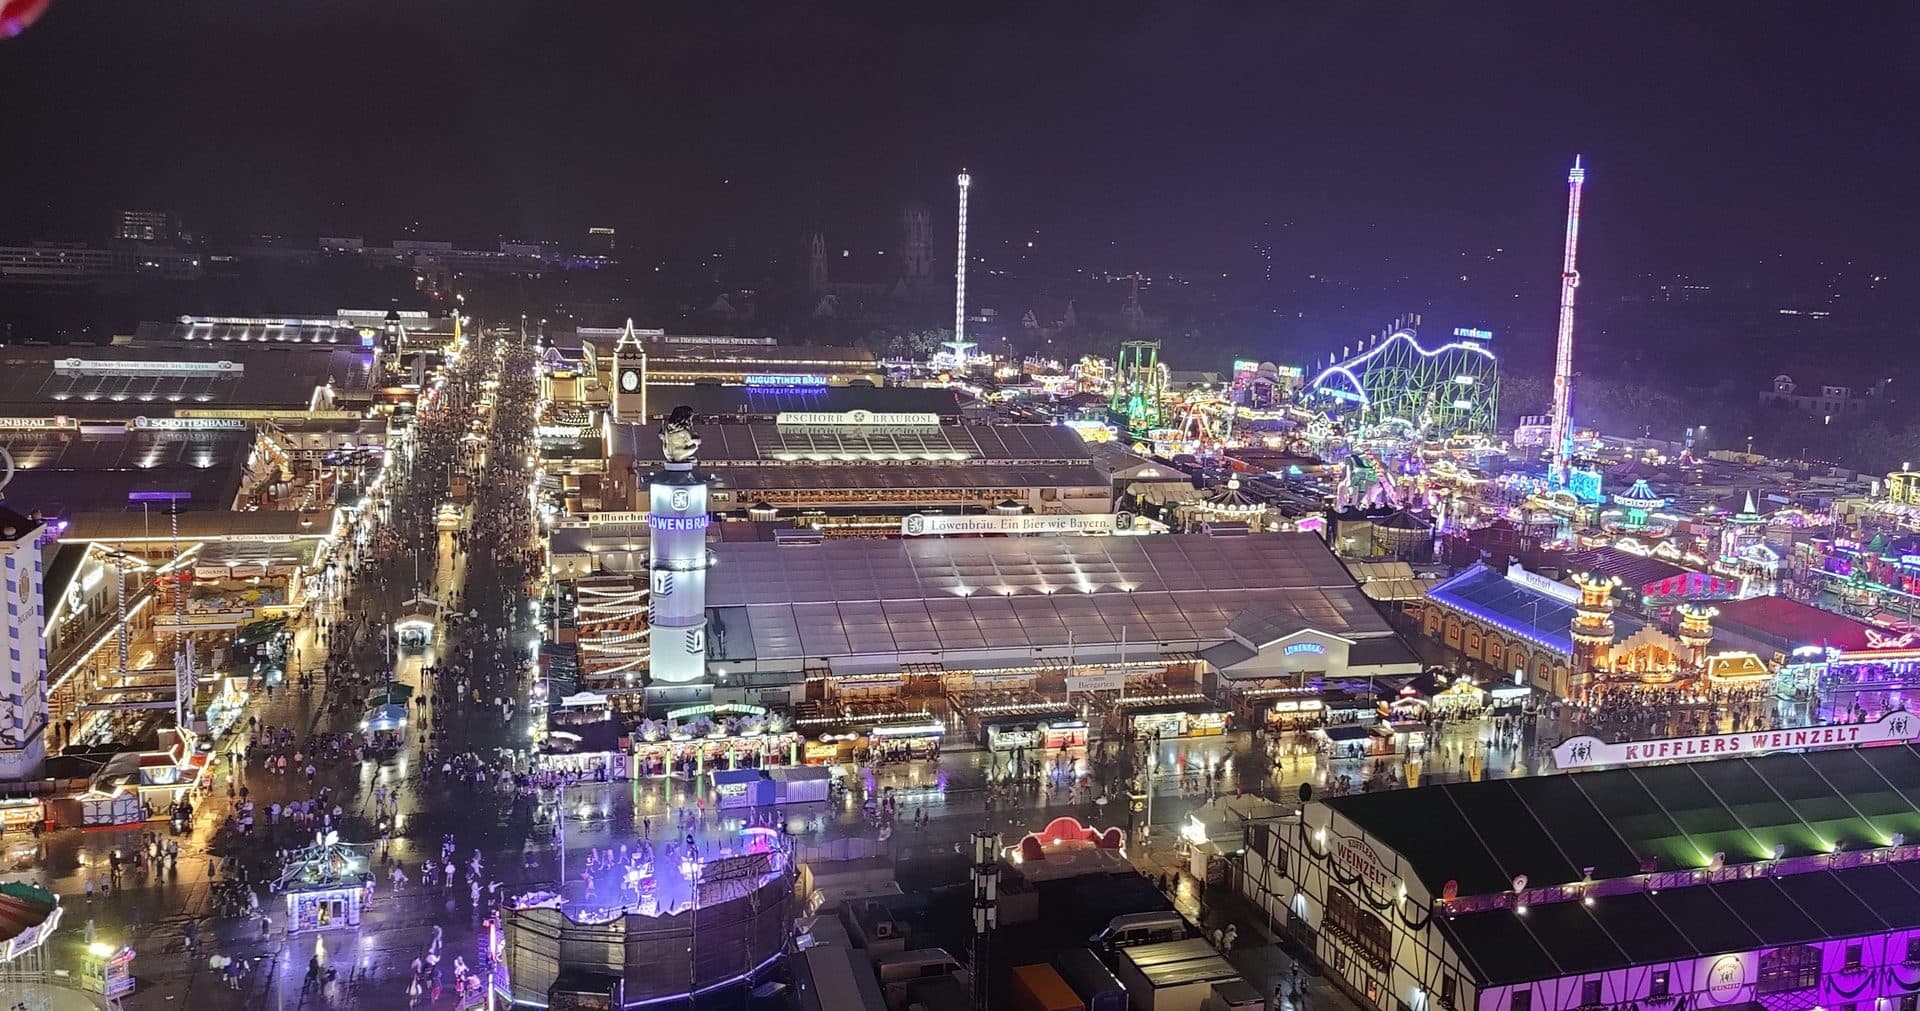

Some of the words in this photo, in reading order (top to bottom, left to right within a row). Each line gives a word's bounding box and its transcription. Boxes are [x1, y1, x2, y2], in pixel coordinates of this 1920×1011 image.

[746, 376, 801, 384] AUGUSTINER
[152, 419, 244, 427] SCHOTTENHAMEL
[785, 414, 844, 423] PSCHORR
[931, 519, 997, 530] Löwenbräu.
[1001, 519, 1019, 529] Ein
[1023, 519, 1045, 529] Bier
[1048, 519, 1066, 529] wie
[1070, 519, 1110, 530] Bayern.
[1626, 737, 1740, 760] KUFFLERS
[1752, 727, 1859, 749] WEINZELT
[1337, 842, 1387, 888] WEINZELT
